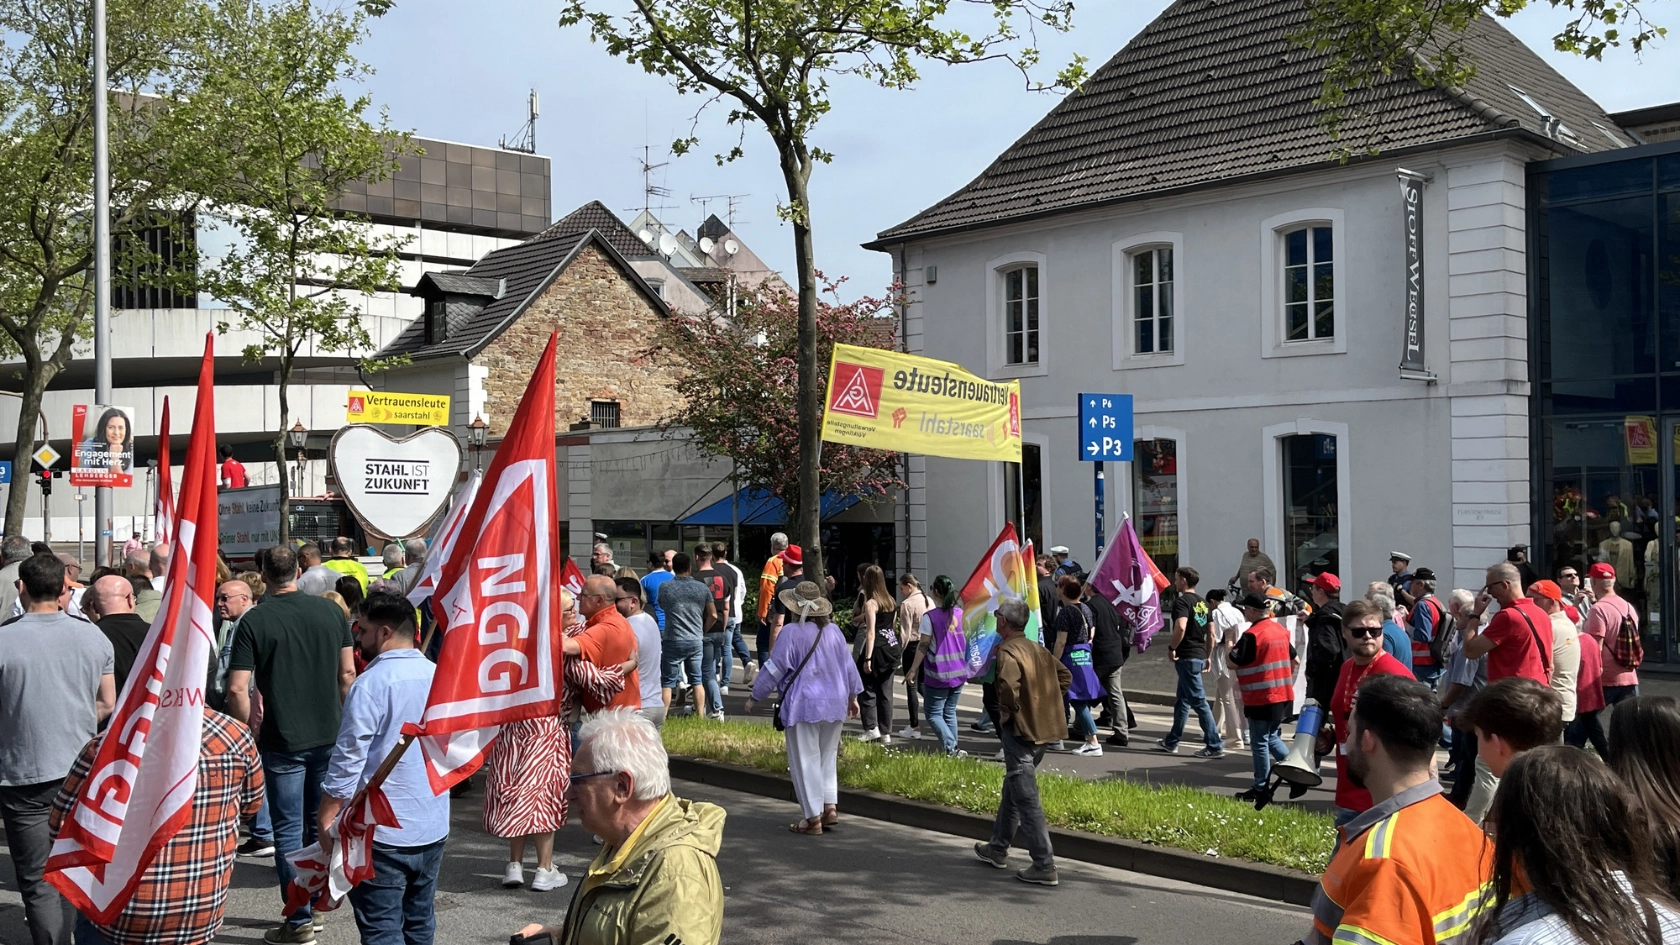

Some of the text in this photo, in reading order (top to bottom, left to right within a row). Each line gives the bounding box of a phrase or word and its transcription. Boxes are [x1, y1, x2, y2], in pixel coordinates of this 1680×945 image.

[366, 395, 446, 409] Vertrauensleute
[1102, 398, 1112, 408] P6
[394, 410, 431, 420] saarstahl
[1102, 415, 1116, 429] P5
[1102, 436, 1122, 456] P3
[74, 449, 131, 459] Engagement
[84, 458, 125, 466] mit Herz.
[365, 463, 430, 477] STAHL IST
[365, 477, 430, 490] ZUKUNFT
[218, 503, 231, 516] Ohne
[477, 553, 529, 693] NGG
